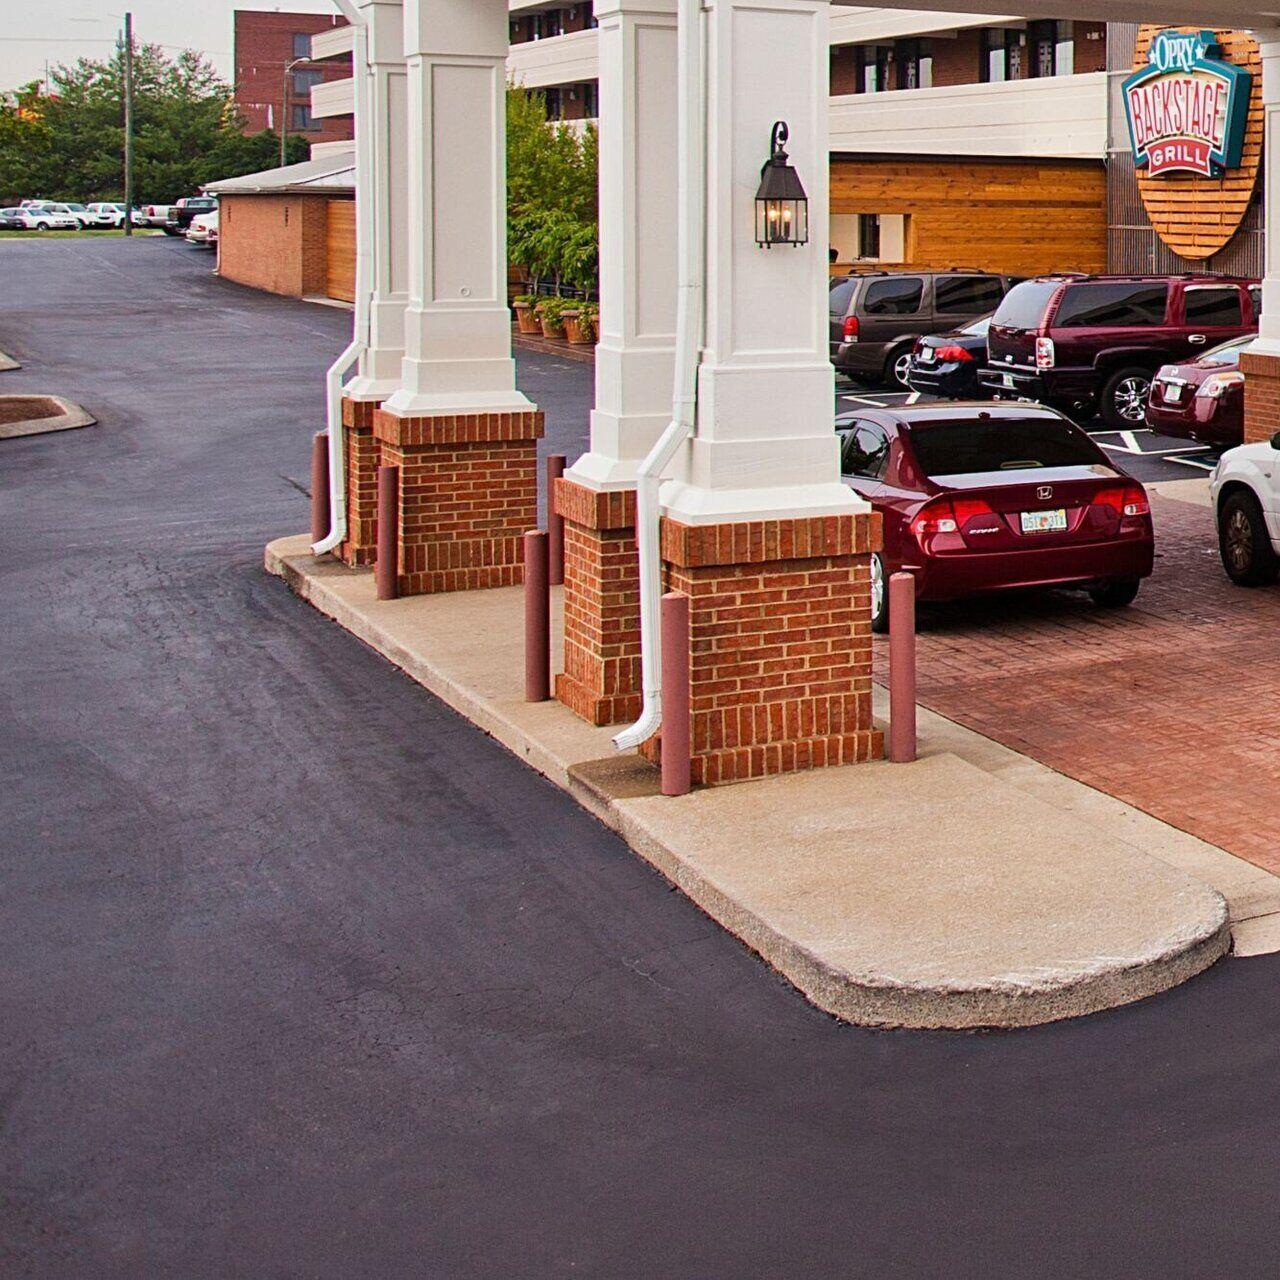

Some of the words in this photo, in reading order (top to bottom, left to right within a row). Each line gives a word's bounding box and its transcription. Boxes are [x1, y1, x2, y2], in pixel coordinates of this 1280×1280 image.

[1155, 35, 1196, 72] OPRY
[1130, 78, 1225, 145] BACKSTAGE
[1151, 145, 1207, 166] GRILL
